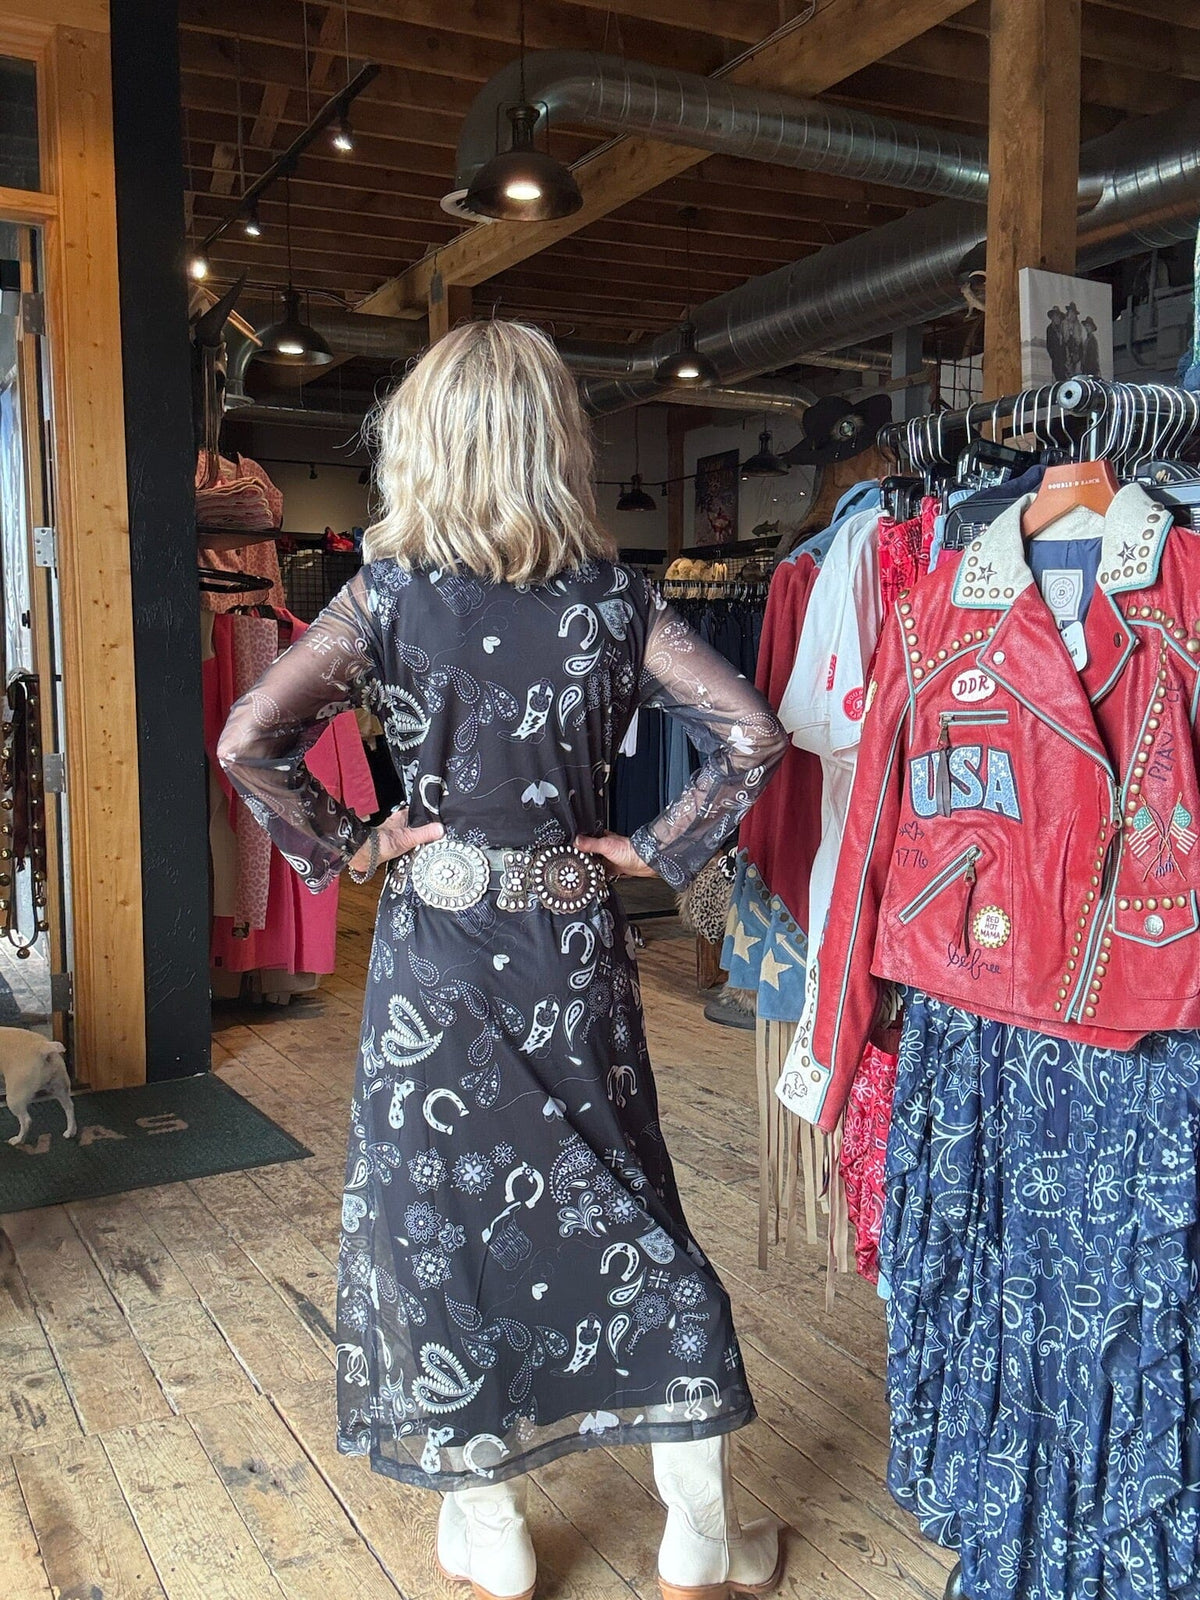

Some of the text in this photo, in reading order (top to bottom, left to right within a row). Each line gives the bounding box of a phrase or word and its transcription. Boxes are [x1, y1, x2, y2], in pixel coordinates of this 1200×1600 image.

[956, 674, 990, 697] DDR
[909, 745, 1023, 824] USA
[895, 847, 929, 869] 1776
[984, 923, 998, 931] HOT
[986, 914, 1000, 924] RED
[980, 929, 1001, 939] MAMA
[946, 941, 1002, 980] be free
